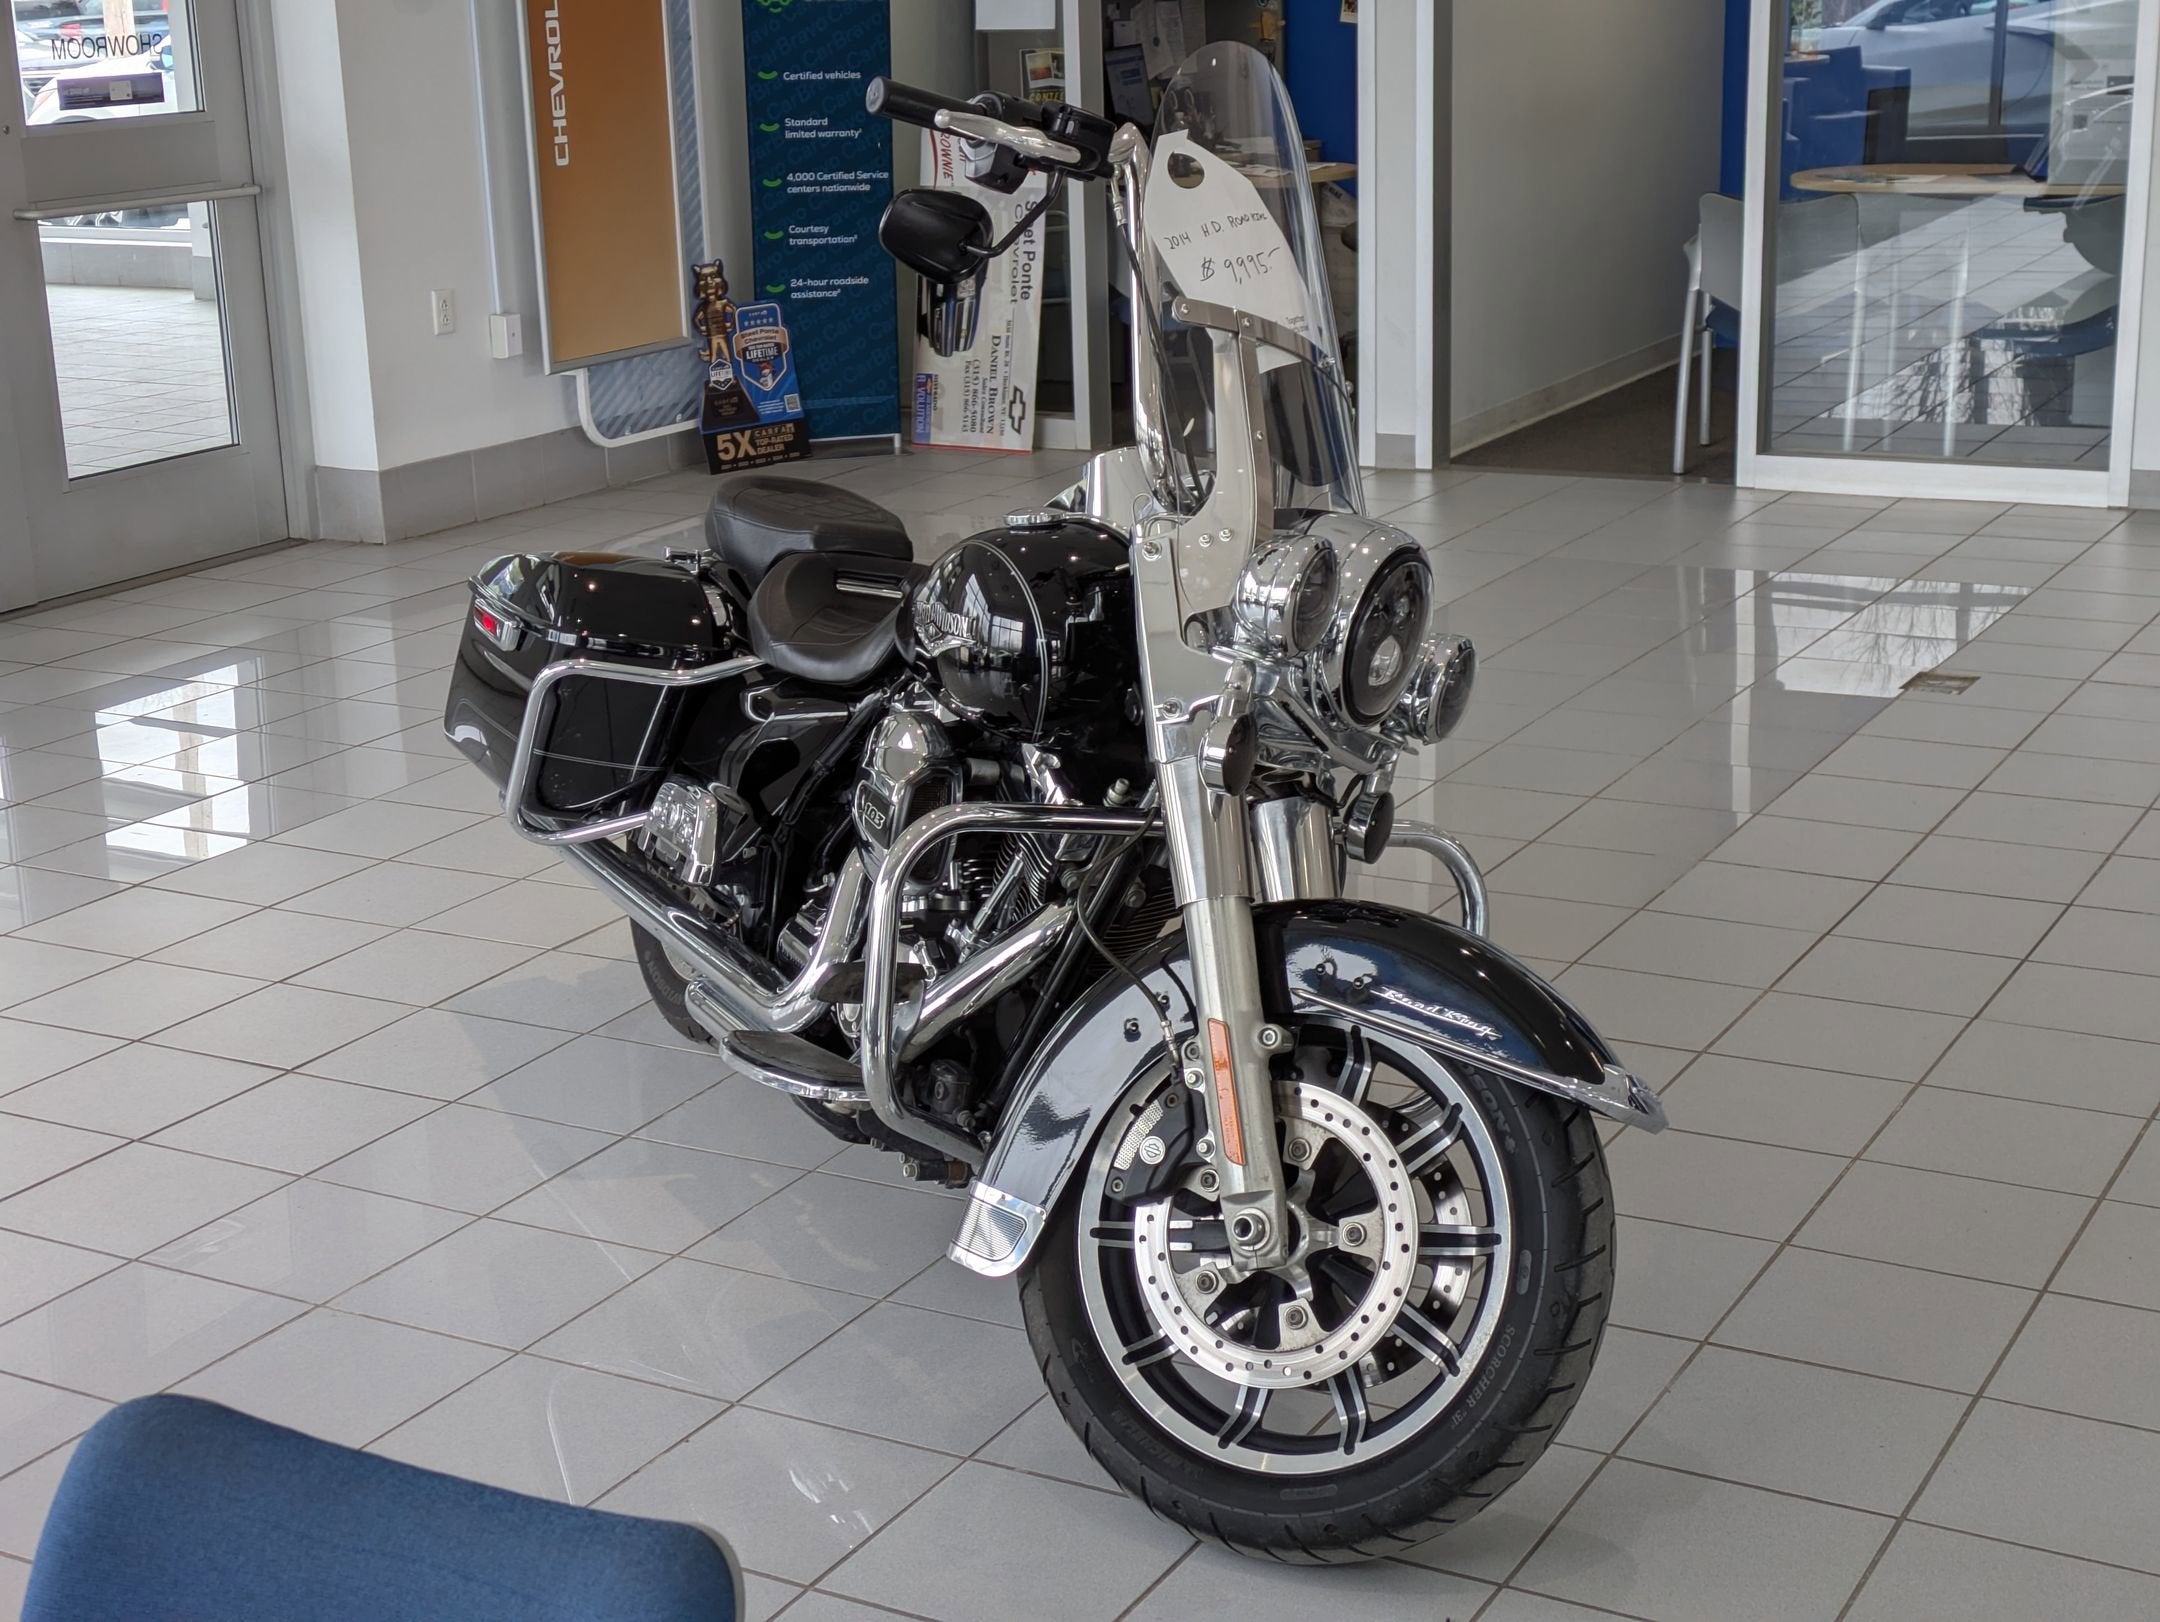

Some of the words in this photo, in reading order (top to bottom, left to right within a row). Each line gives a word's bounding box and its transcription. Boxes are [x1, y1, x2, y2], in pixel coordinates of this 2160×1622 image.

[783, 71, 823, 81] Certified
[825, 71, 861, 80] vehicles
[784, 117, 828, 127] Standard
[785, 129, 816, 139] limited
[787, 172, 815, 182] 4,000
[817, 171, 855, 181] Certified
[856, 170, 889, 179] Service
[787, 185, 820, 194] centers
[822, 183, 871, 192] nationwide
[788, 225, 829, 234] Courtesy
[1164, 232, 1192, 250] 2014
[790, 278, 828, 287] 24-hour
[830, 276, 869, 286] roadside
[1020, 250, 1037, 300] Ponte
[746, 347, 779, 360] LIFETIME
[989, 335, 1001, 383] DANIEL
[986, 387, 999, 434] BROWN
[716, 430, 757, 461] 5X
[755, 434, 794, 447] TOP-RATED
[757, 444, 785, 455] DEALER
[864, 802, 886, 829] 103
[1465, 1323, 1516, 1408] SCORCHER
